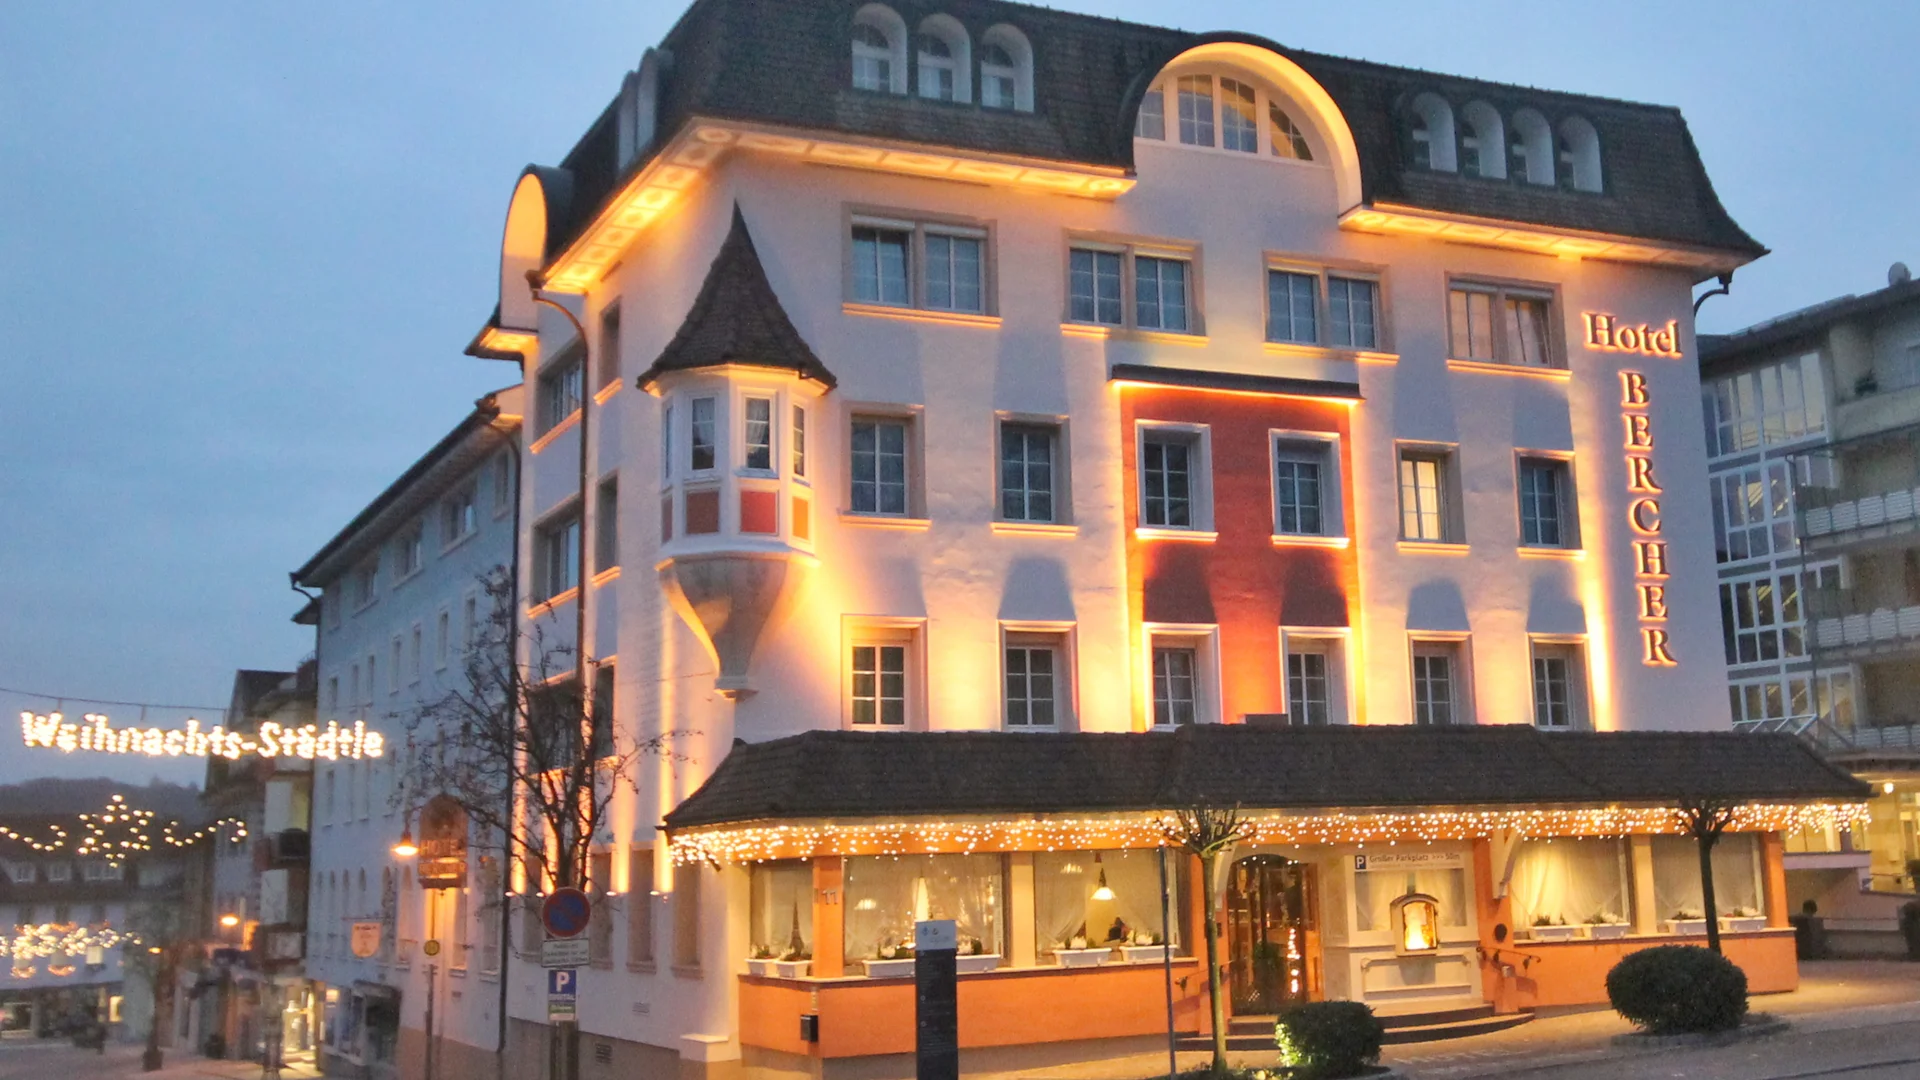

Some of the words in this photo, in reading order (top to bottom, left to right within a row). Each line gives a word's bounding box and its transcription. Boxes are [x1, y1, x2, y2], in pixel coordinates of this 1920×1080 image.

[1581, 311, 1682, 358] Hotel
[1618, 370, 1677, 666] BERCHER
[20, 711, 384, 760] Weihnachts-Städtle
[1356, 856, 1365, 869] P
[1396, 853, 1429, 862] Parkplatz
[556, 971, 570, 992] P
